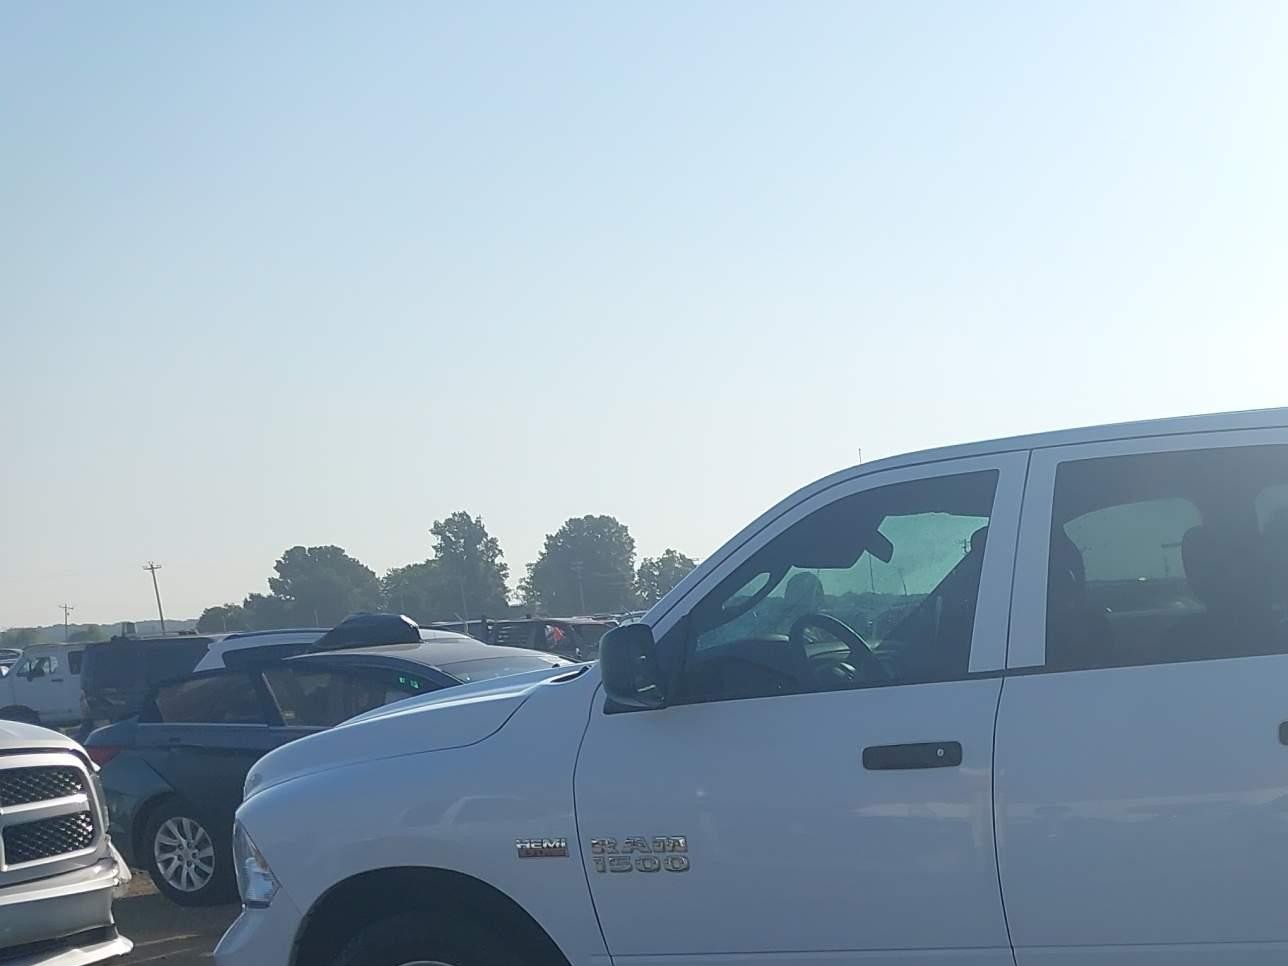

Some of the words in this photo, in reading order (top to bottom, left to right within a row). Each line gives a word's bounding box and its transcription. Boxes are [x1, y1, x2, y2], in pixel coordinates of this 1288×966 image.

[516, 839, 566, 849] HEMI
[592, 835, 688, 854] RAM
[592, 855, 690, 873] 1500
